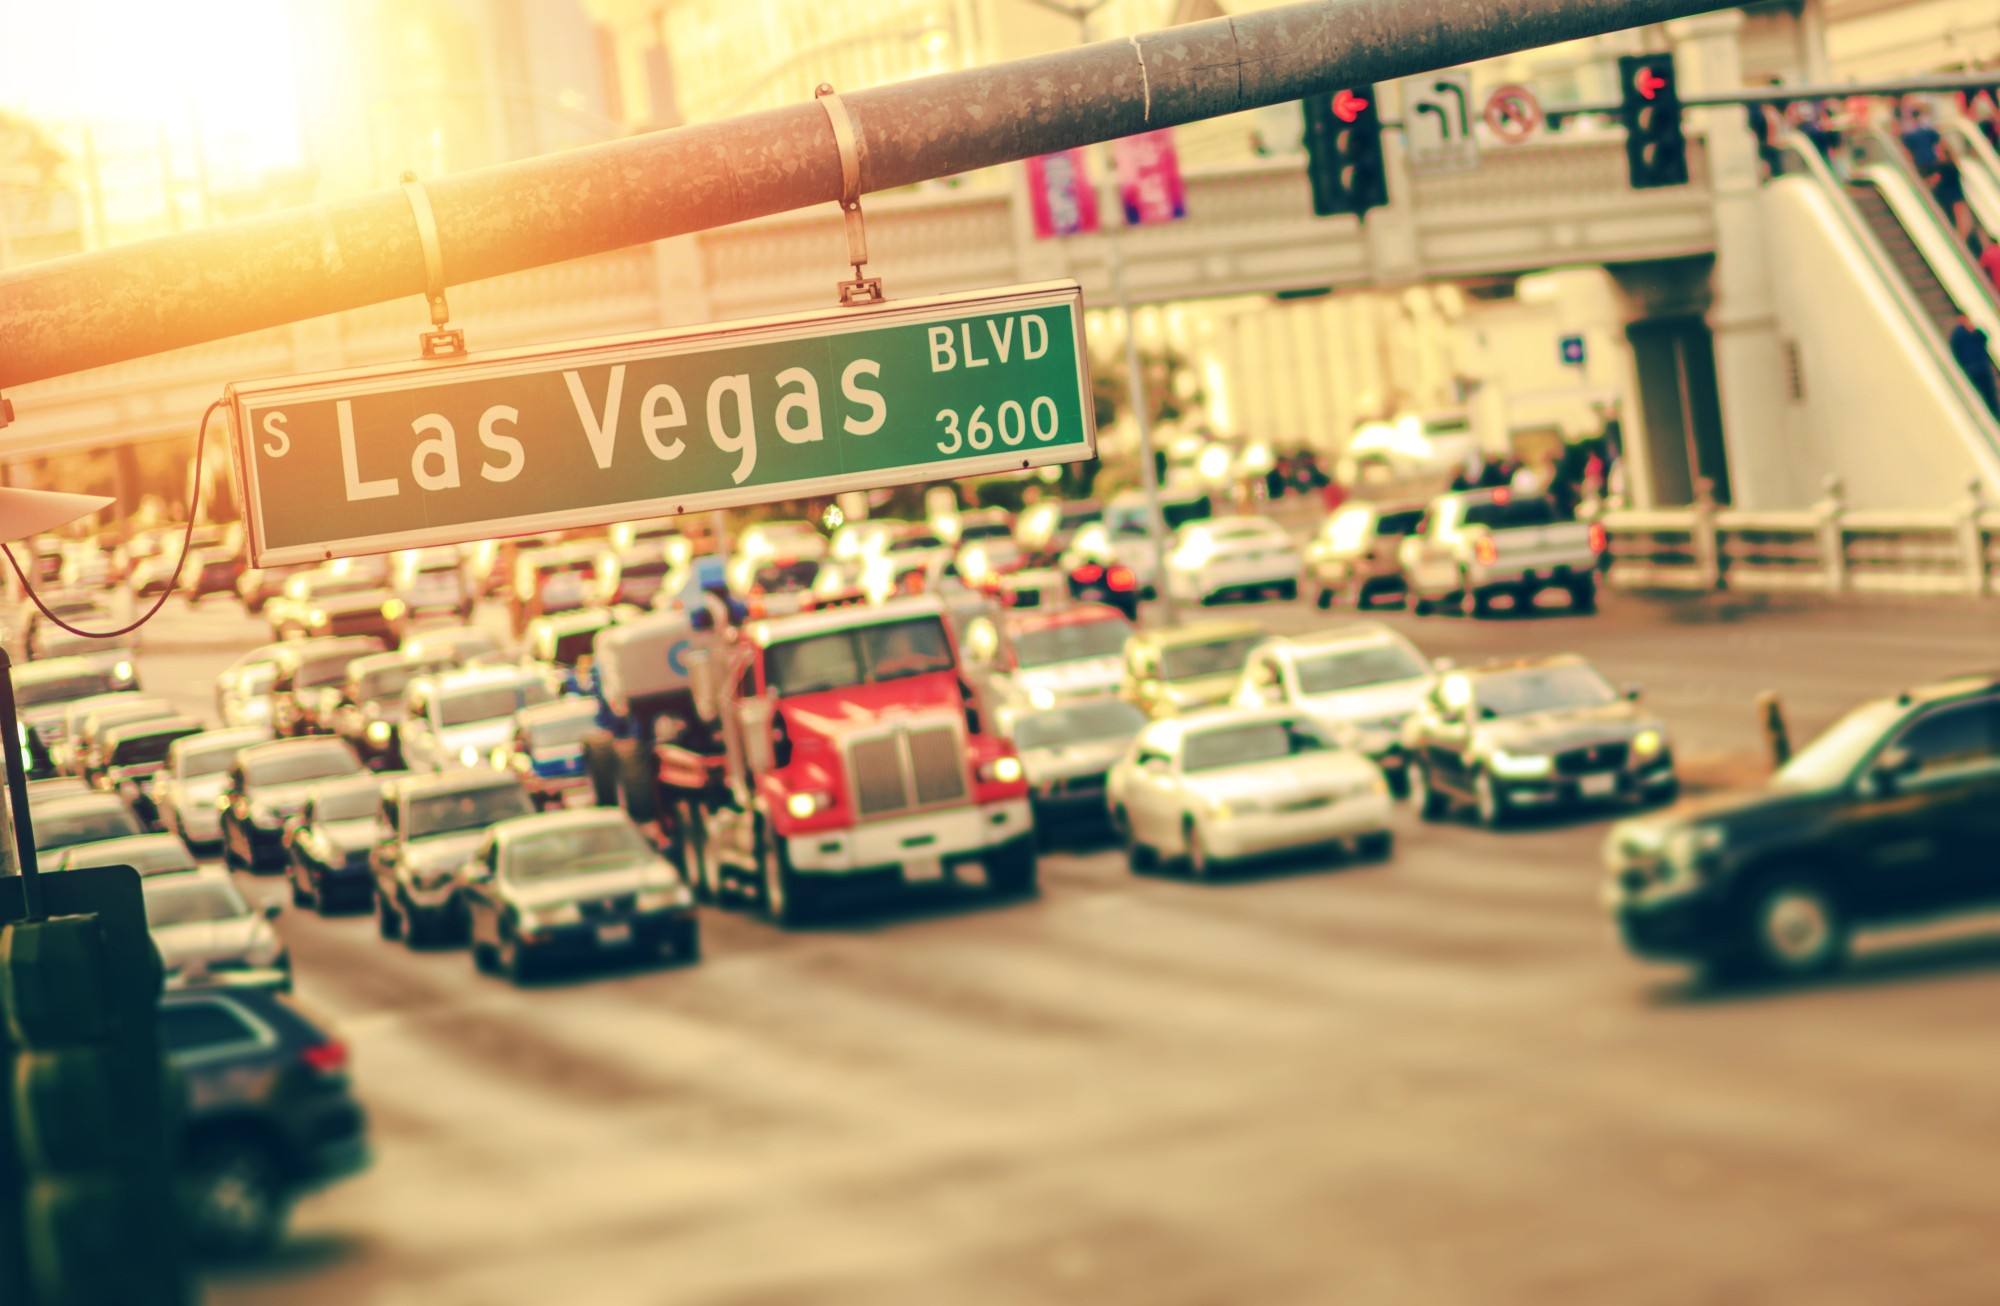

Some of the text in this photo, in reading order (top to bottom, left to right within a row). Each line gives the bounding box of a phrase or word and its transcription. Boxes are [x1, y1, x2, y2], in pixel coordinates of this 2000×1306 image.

[927, 314, 1049, 373] BLVD
[262, 411, 291, 458] S
[336, 399, 525, 501] Las
[562, 358, 887, 485] Vegas
[935, 396, 1059, 454] 3600
